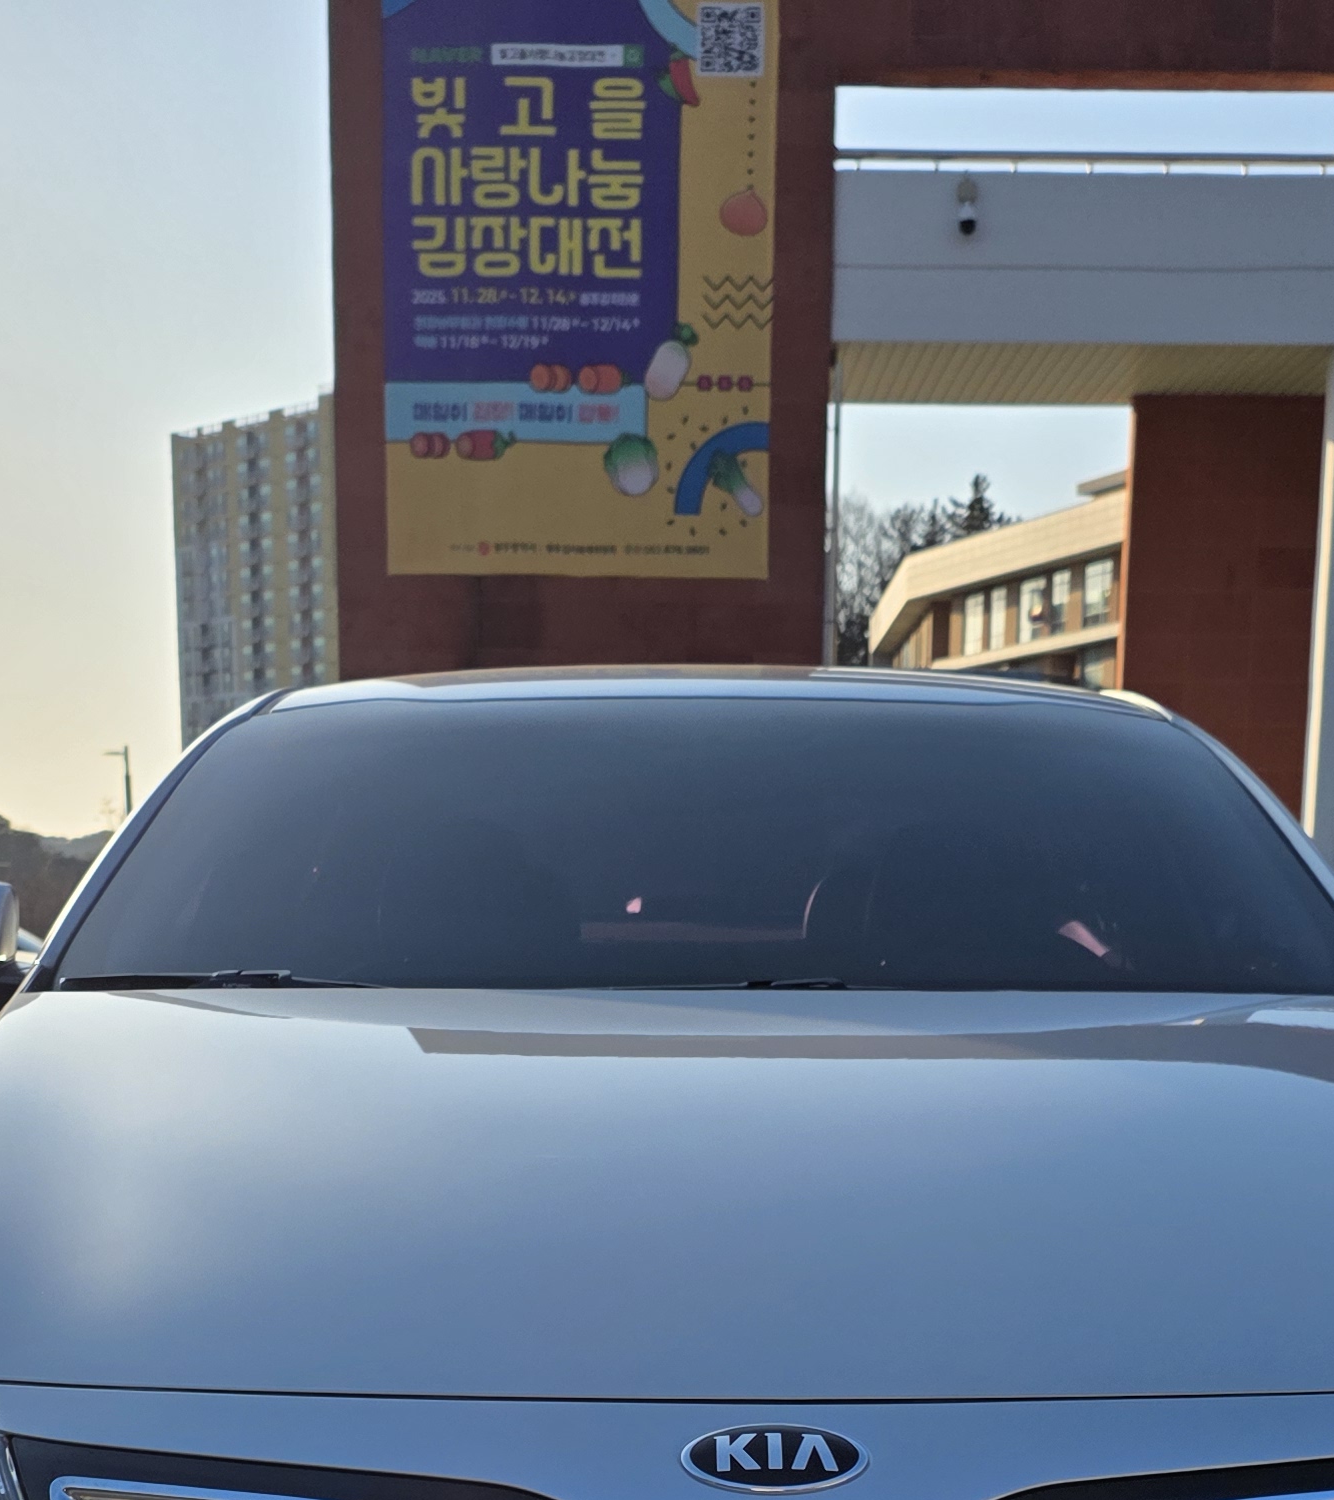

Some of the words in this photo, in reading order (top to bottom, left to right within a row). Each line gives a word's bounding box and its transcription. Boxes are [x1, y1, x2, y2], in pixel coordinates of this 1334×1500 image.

[411, 147, 646, 210] 사랑나눔
[411, 216, 643, 279] 김장대전
[713, 1432, 839, 1473] KIA
